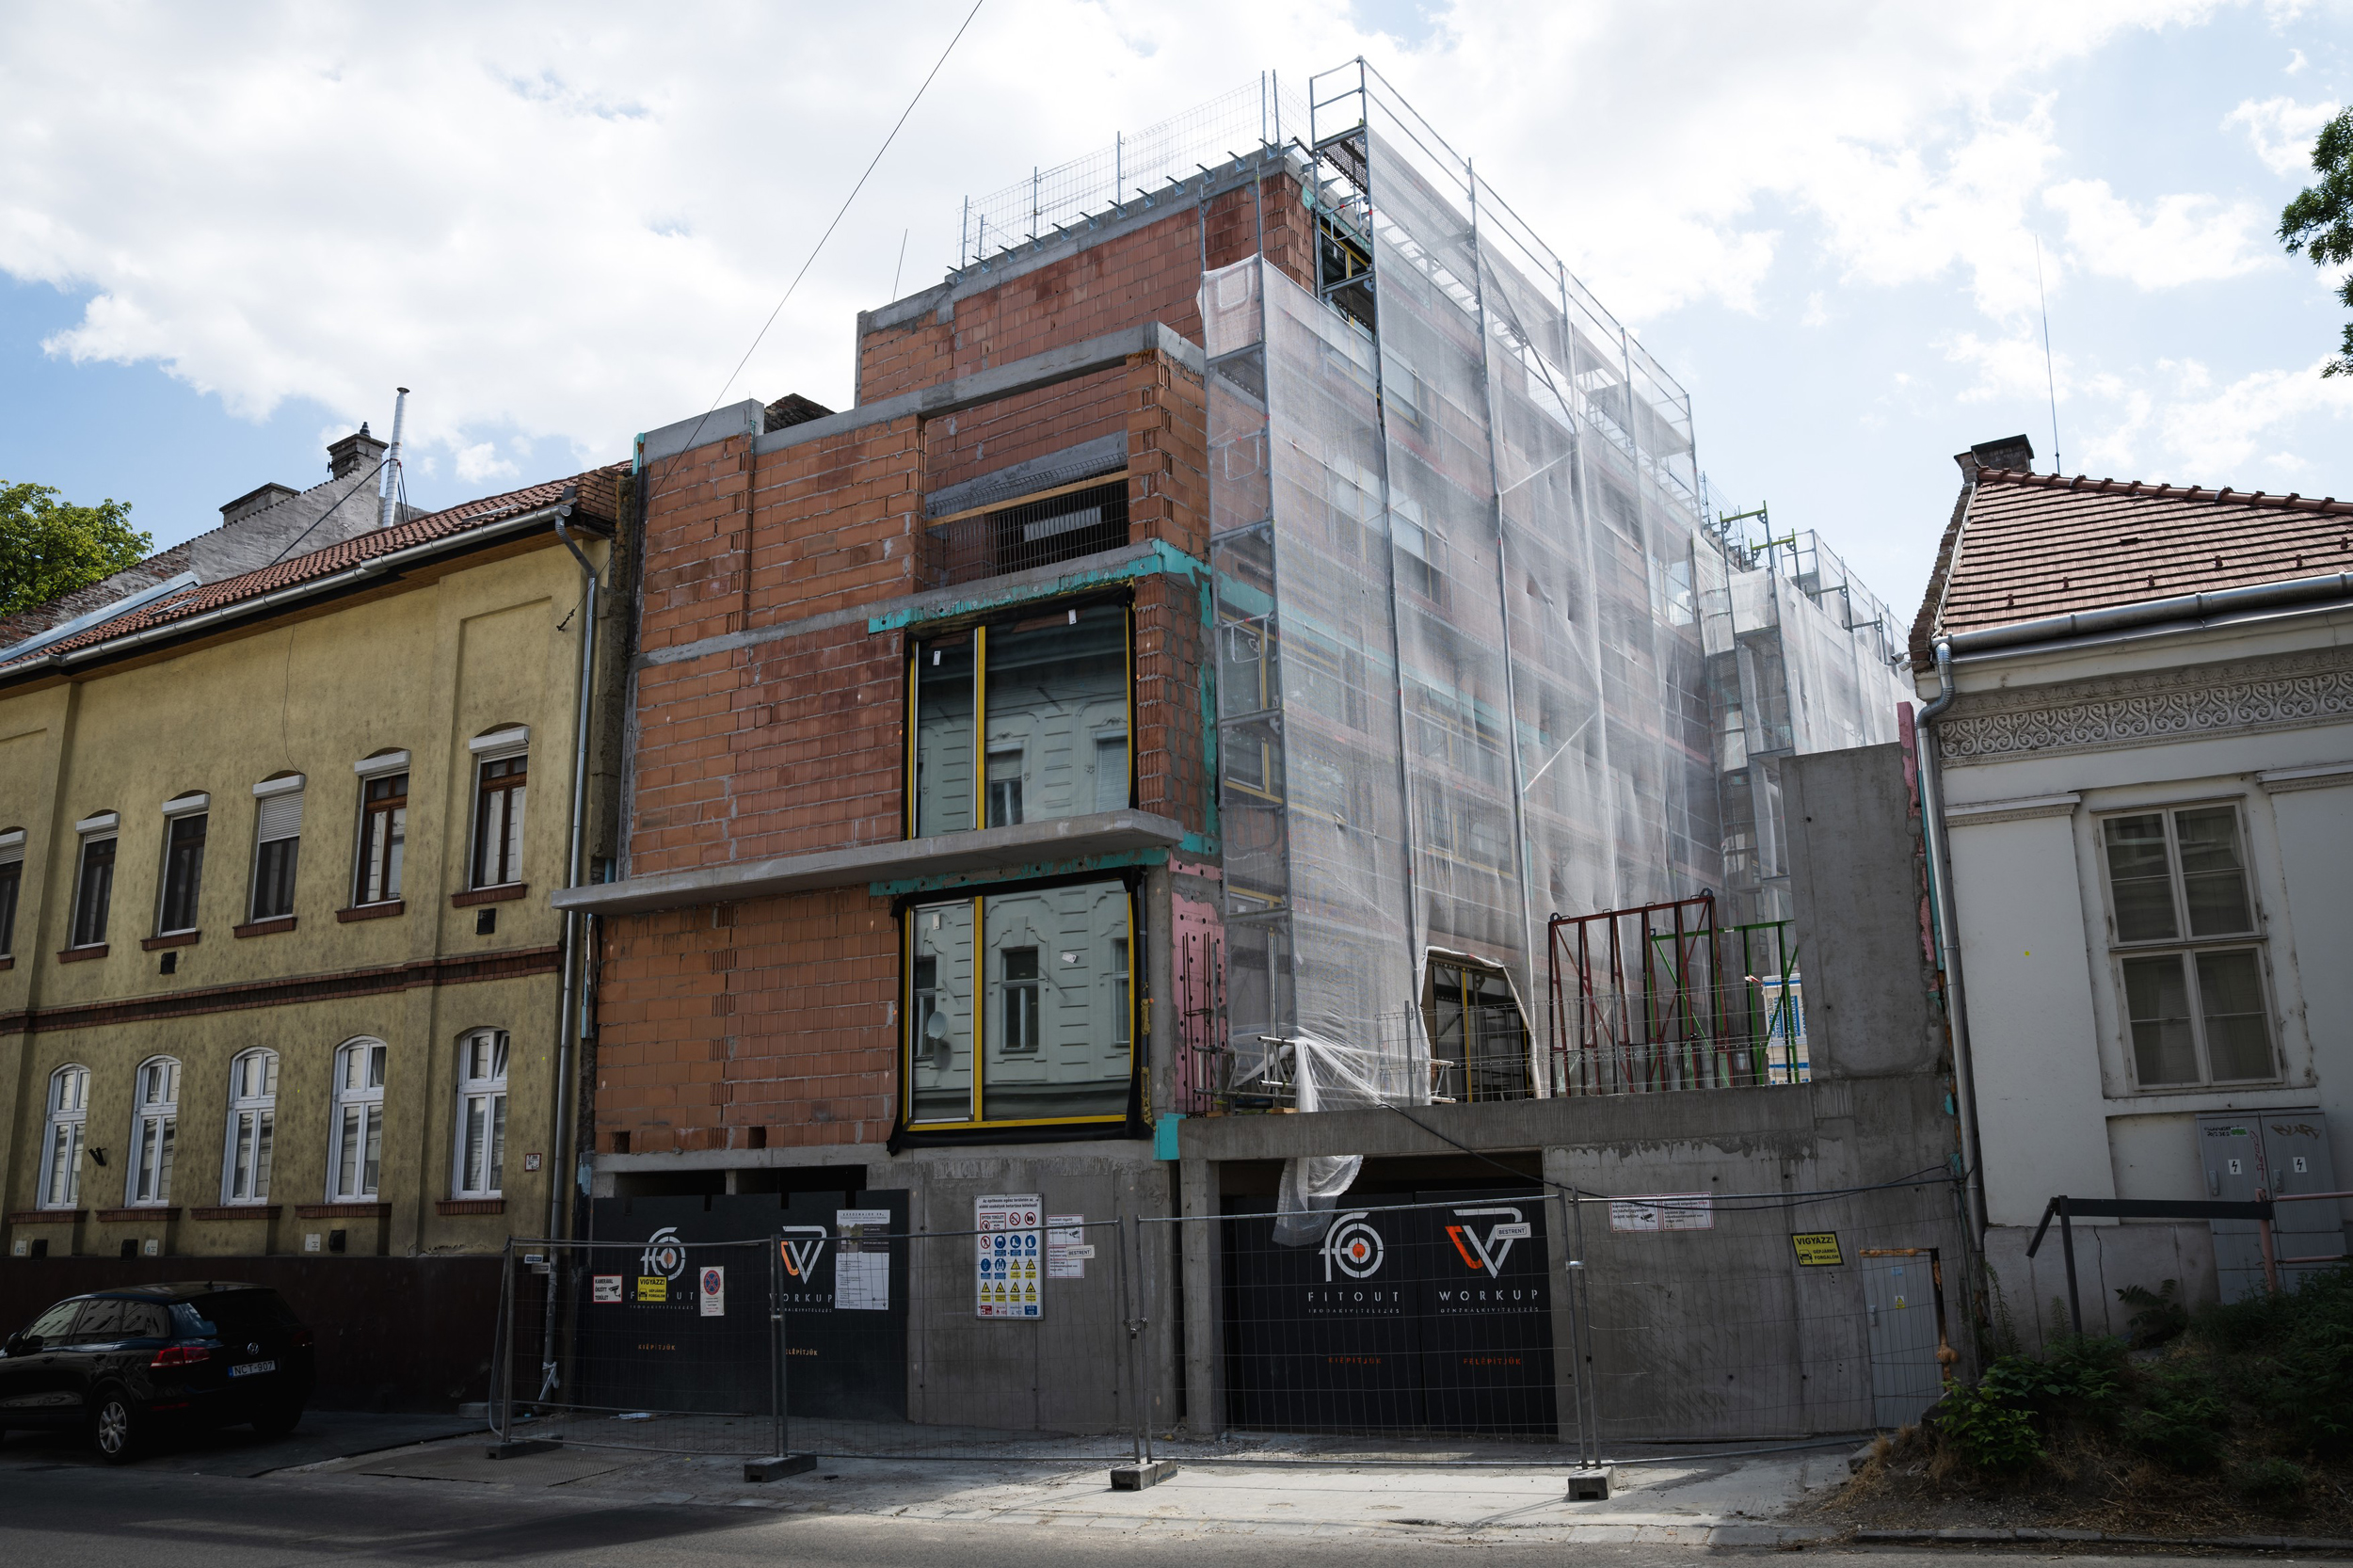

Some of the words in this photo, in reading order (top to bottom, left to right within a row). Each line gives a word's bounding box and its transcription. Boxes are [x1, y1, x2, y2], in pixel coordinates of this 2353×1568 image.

[1797, 1236, 1833, 1244] VIGYÁZZ!
[1308, 1291, 1399, 1302] FITOUT
[1438, 1288, 1538, 1301] WORKUP
[1440, 1305, 1539, 1314] GENERÁLKIVITELEZÉS
[638, 1342, 676, 1351] KIÉPÍTJÜK
[785, 1347, 818, 1356] ELÉPÍTJÜK
[1327, 1355, 1382, 1365] KIÉPÍTJÜK
[1463, 1355, 1523, 1366] FELÉPÍTJÜK
